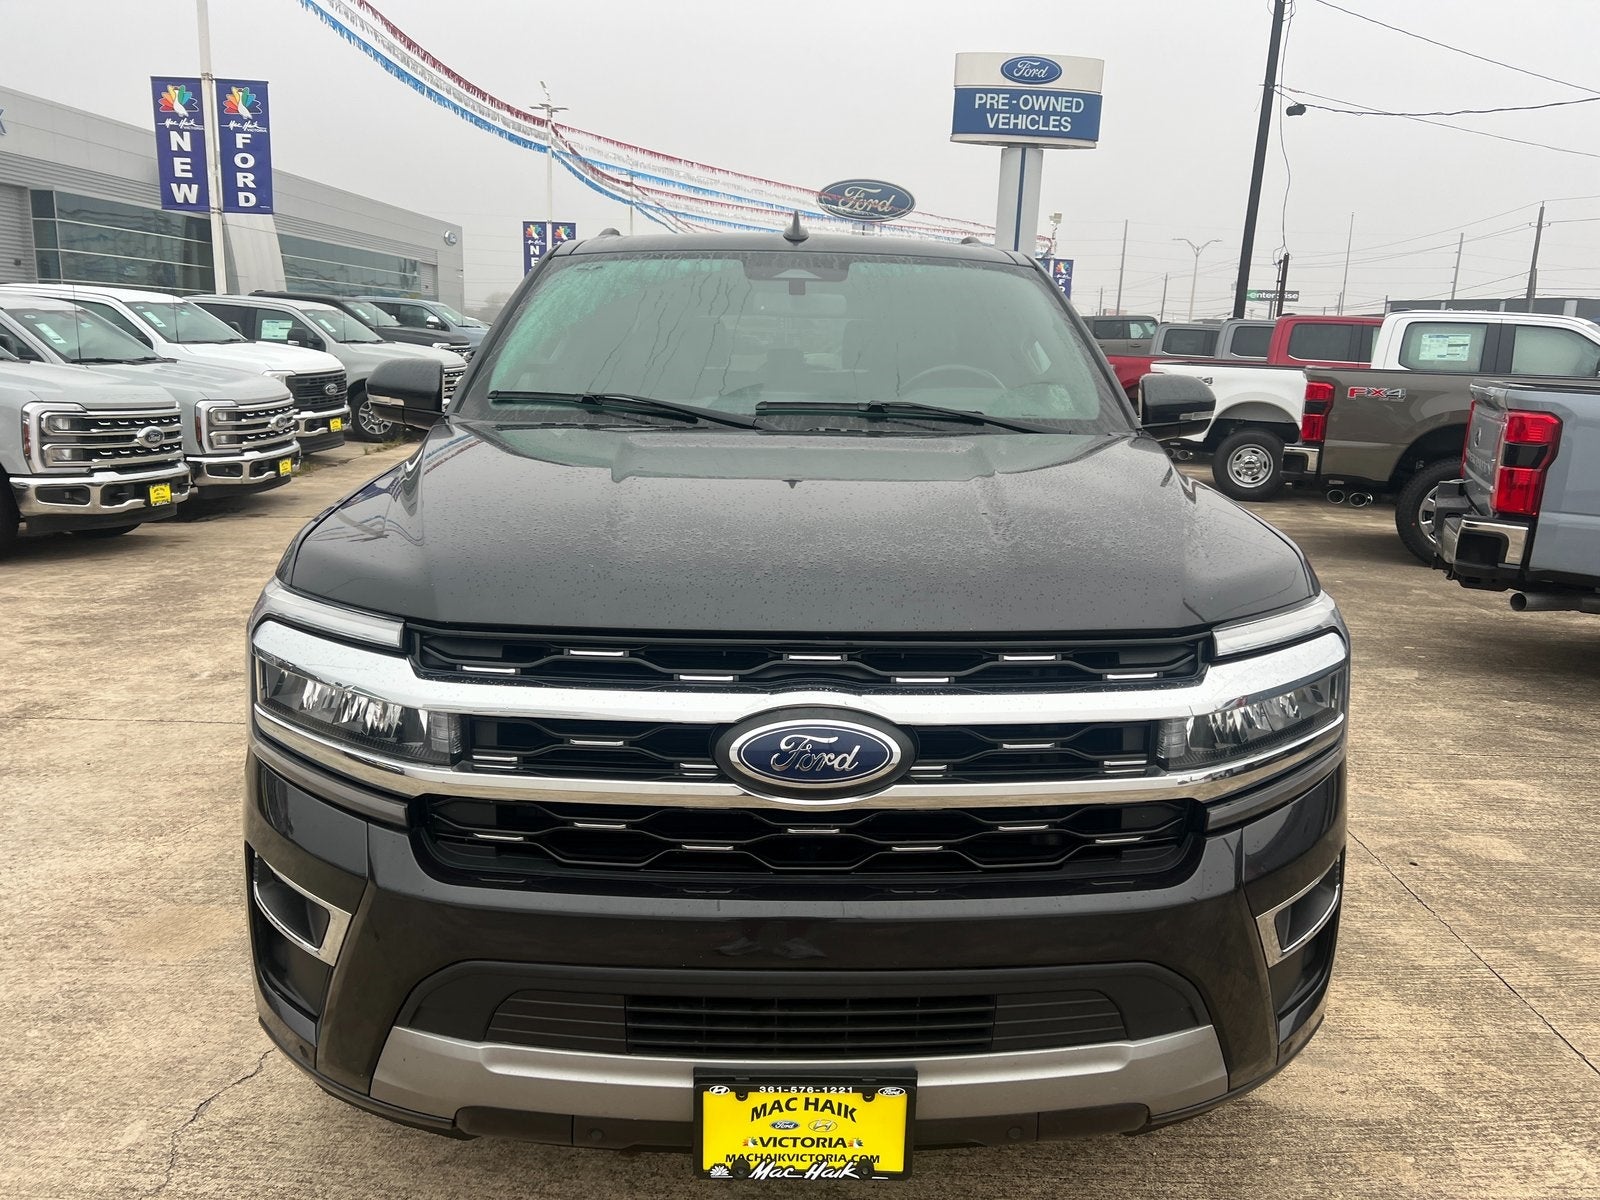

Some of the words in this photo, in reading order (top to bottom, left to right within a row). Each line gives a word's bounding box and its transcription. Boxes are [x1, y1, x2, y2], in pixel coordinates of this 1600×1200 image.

[1014, 60, 1048, 79] Ford
[986, 113, 1071, 132] VEHICLES
[170, 130, 199, 204] NEW
[234, 133, 257, 207] FORD
[838, 186, 896, 212] Ford
[530, 245, 540, 268] NE
[1247, 291, 1299, 299] enterise
[1347, 386, 1406, 401] FX4
[770, 734, 861, 772] Ford
[759, 1086, 854, 1094] 361-576-1221
[750, 1097, 798, 1122] MAC
[804, 1097, 857, 1123] HAIK
[759, 1136, 847, 1149] VICTORIA
[748, 1160, 803, 1180] Mac
[803, 1161, 860, 1180] Haik
